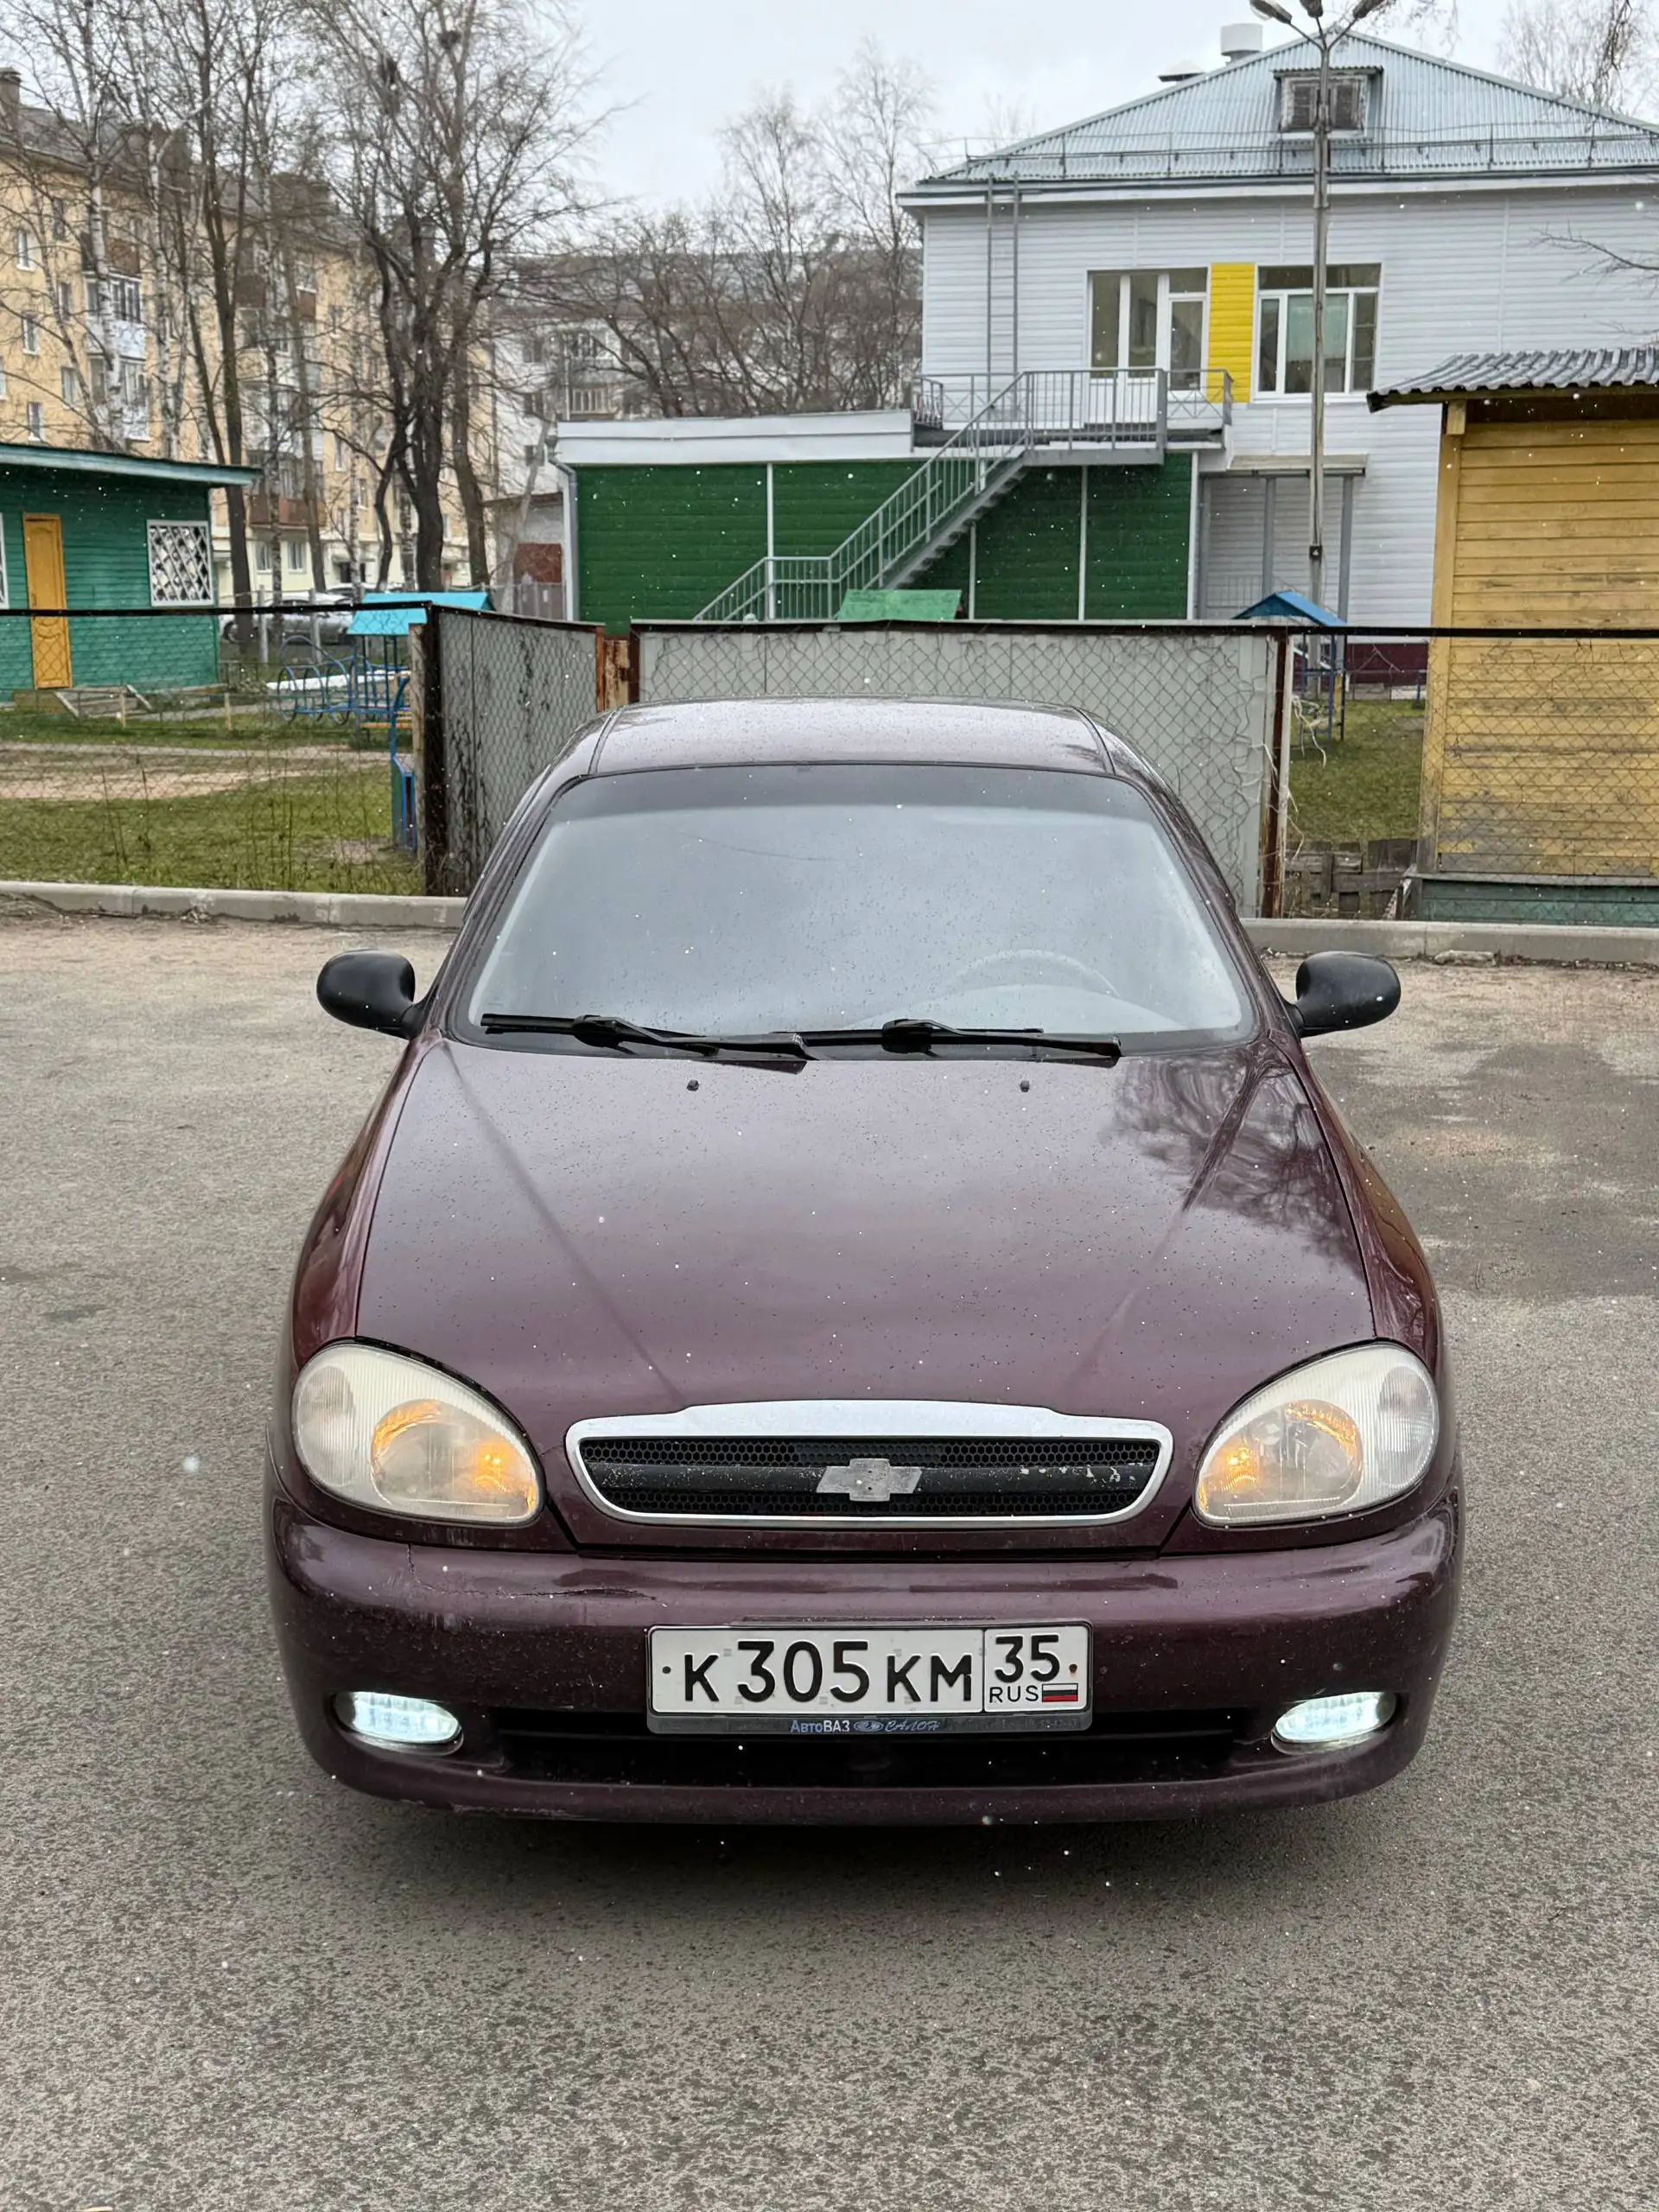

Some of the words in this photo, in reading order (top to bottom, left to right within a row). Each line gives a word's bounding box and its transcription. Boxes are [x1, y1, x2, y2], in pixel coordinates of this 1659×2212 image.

[994, 1634, 1060, 1683] 35
[988, 1684, 1039, 1704] RUS
[790, 1719, 850, 1733] АвтоВАЗ
